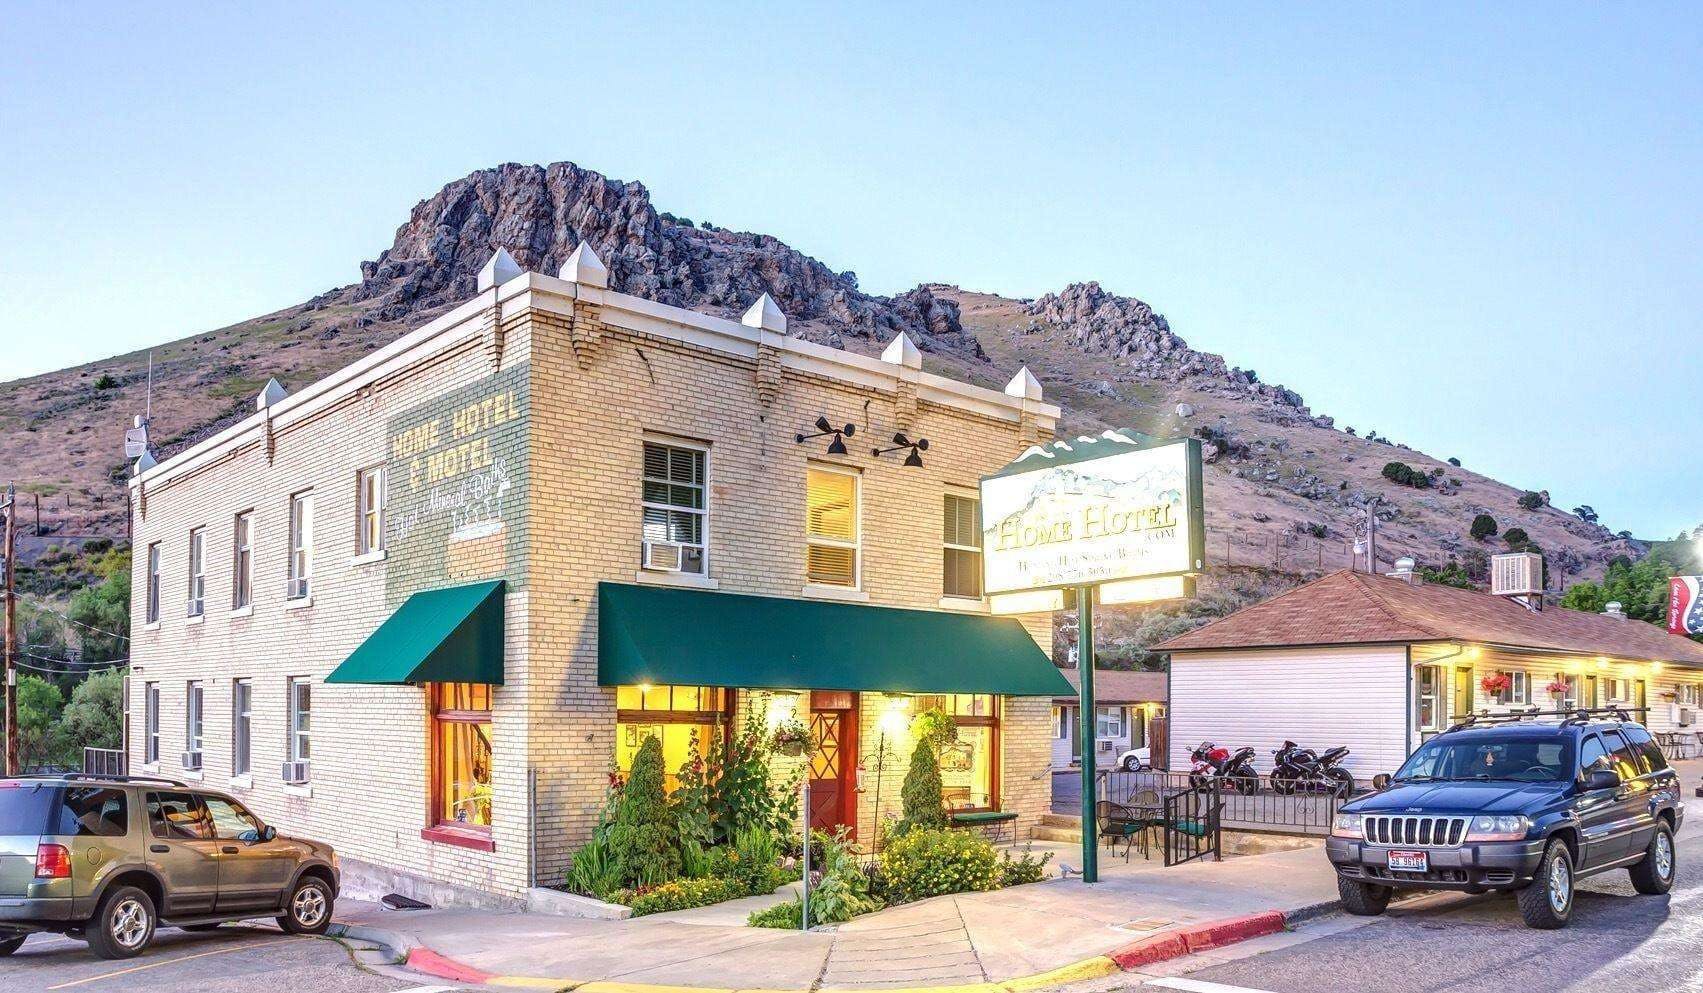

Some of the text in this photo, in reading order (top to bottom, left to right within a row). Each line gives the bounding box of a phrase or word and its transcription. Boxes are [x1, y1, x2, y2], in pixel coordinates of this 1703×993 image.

[393, 391, 518, 459] HOME HOTEL
[427, 436, 493, 482] MOTEL
[422, 479, 470, 514] Mineral
[1080, 504, 1177, 539] HOTEL
